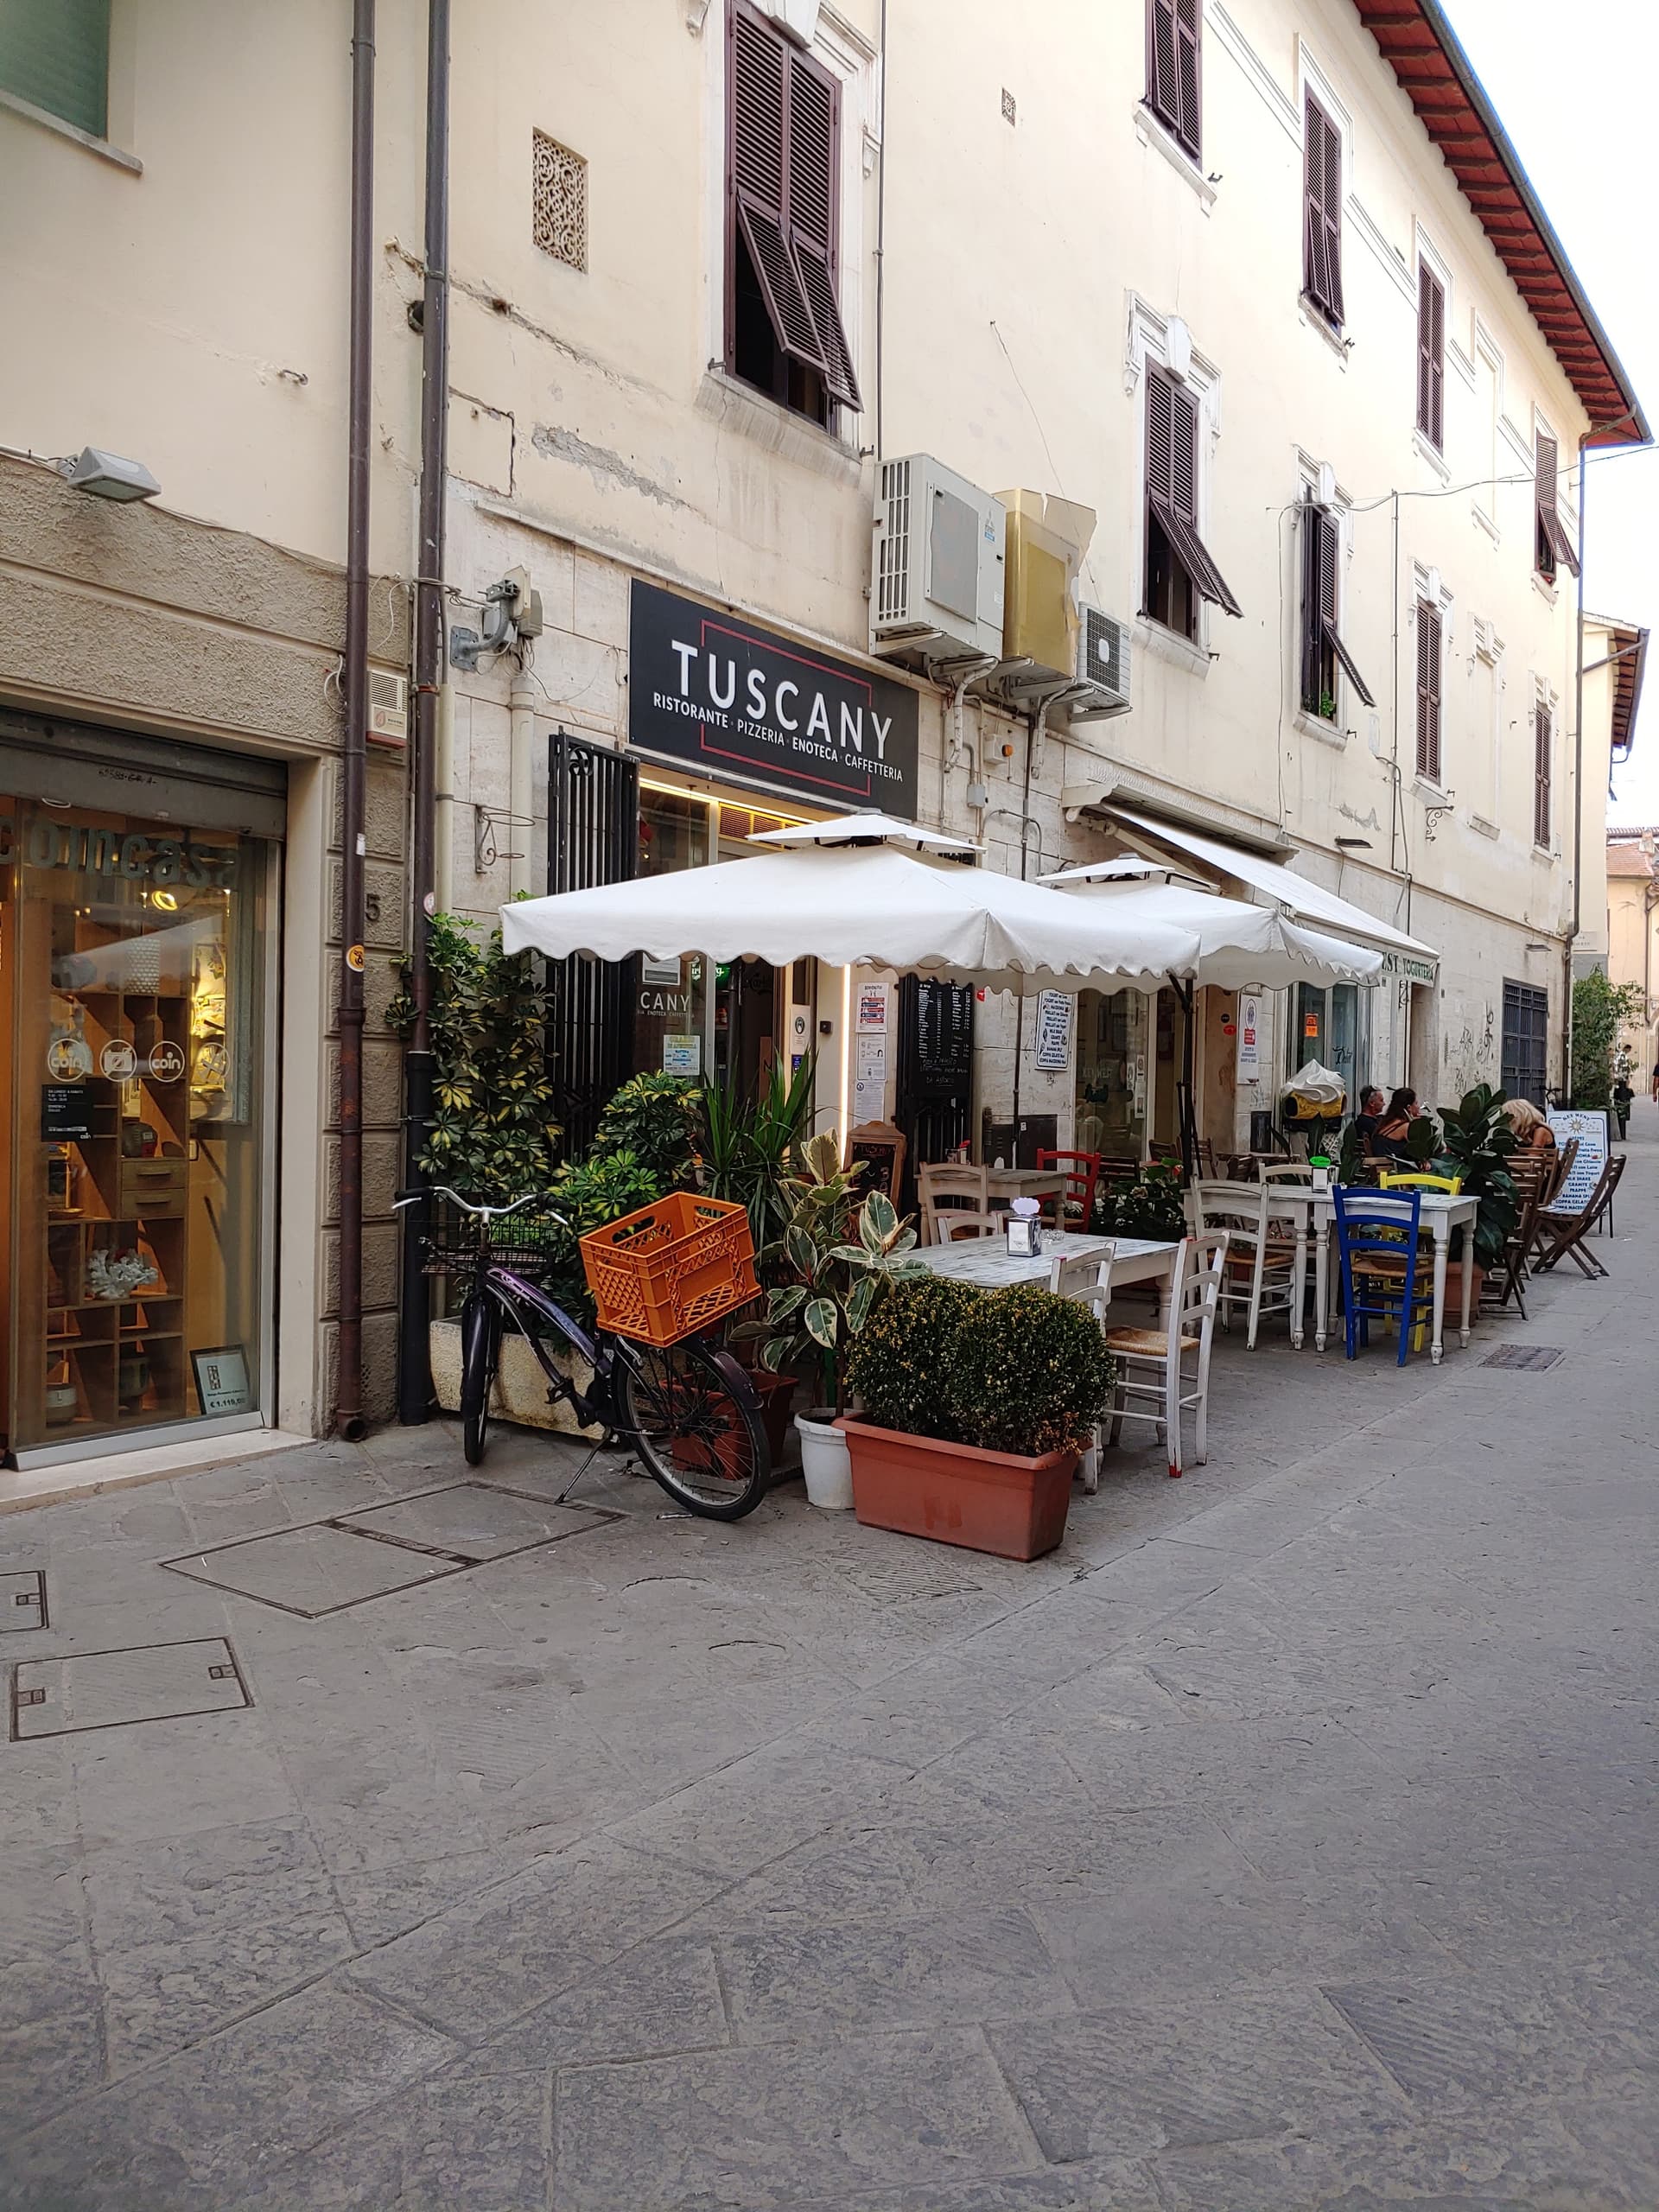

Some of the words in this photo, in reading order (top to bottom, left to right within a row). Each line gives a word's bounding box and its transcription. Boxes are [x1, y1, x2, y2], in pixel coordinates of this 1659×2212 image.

[671, 640, 892, 760] TUSCANY
[653, 691, 728, 728] RISTORANTE
[737, 718, 785, 747] PIZZERIA
[791, 736, 838, 762] ENOTECA
[845, 753, 903, 782] CAFFETTERIA
[640, 991, 690, 1012] CANY
[51, 1049, 83, 1068] coin
[151, 1052, 181, 1070] coin
